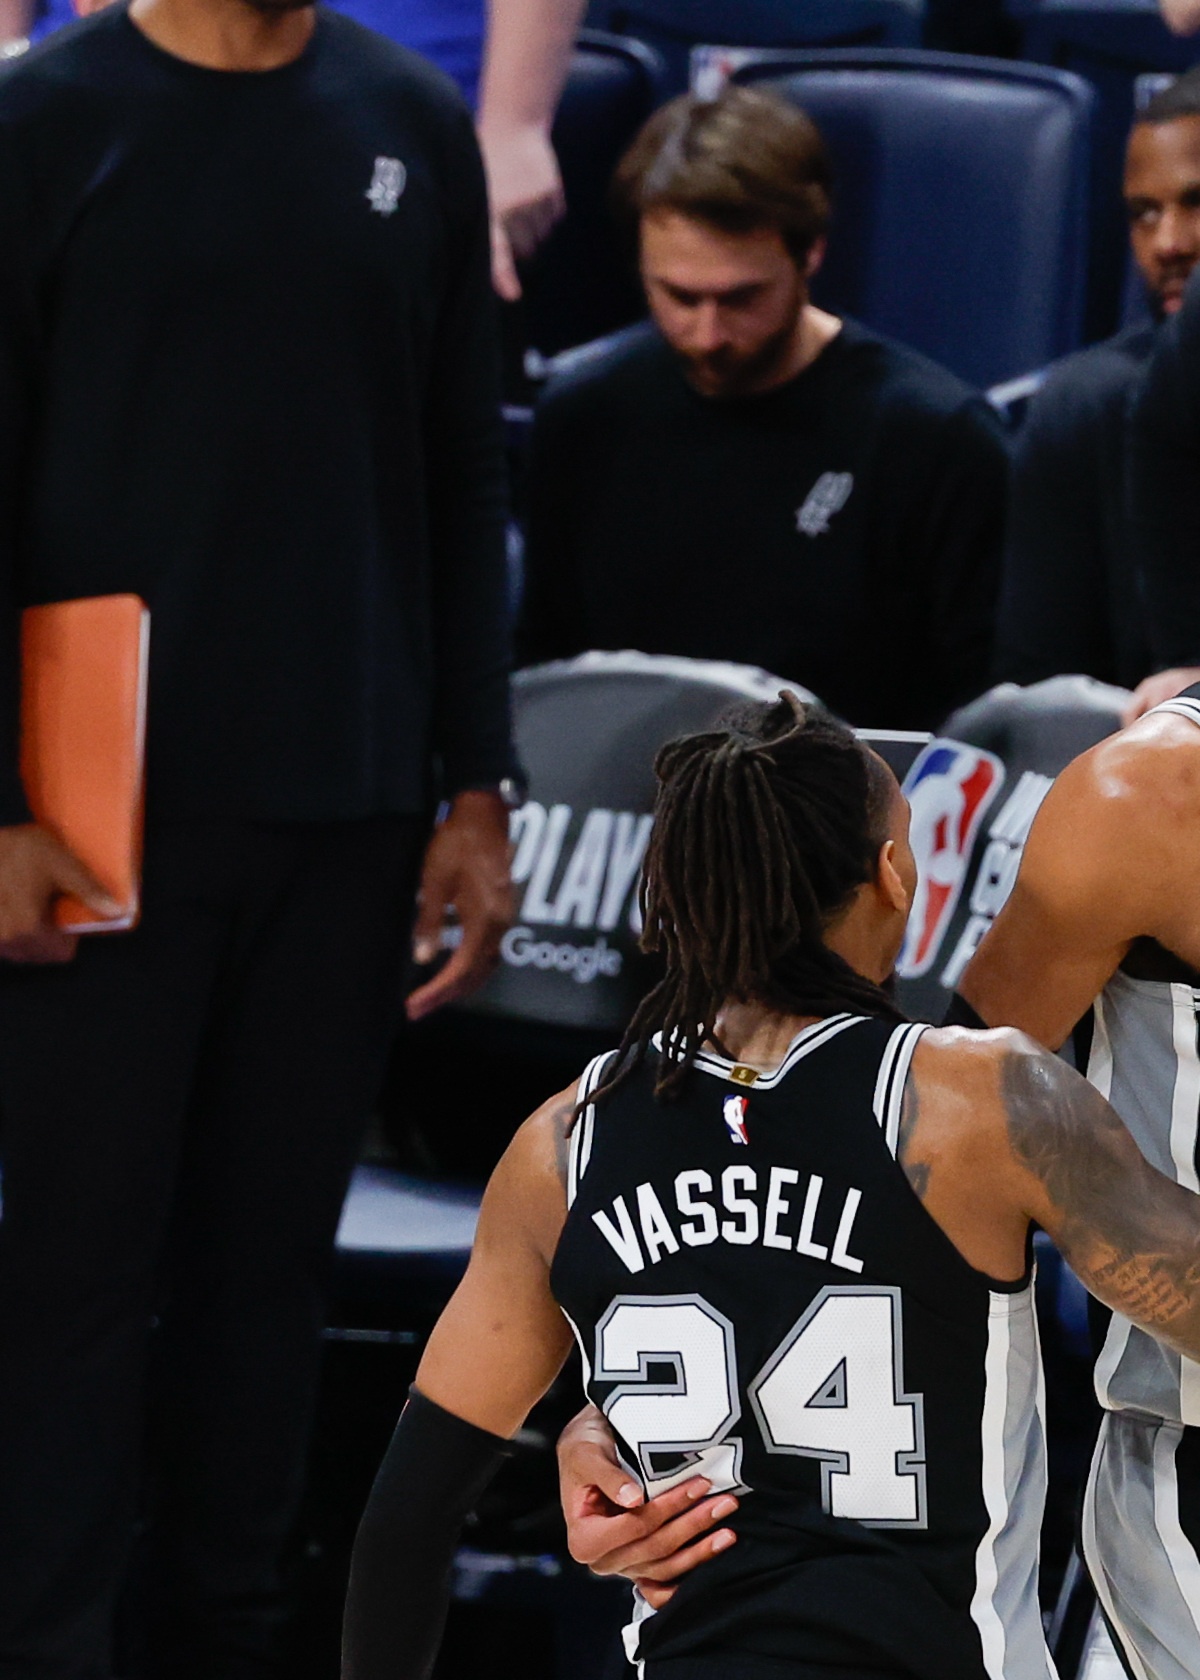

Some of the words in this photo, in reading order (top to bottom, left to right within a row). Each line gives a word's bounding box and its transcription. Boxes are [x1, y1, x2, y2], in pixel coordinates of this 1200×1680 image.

[509, 801, 655, 933] PLAY
[500, 926, 623, 983] Google
[591, 1165, 864, 1274] VASSELL
[594, 1285, 928, 1530] 24
